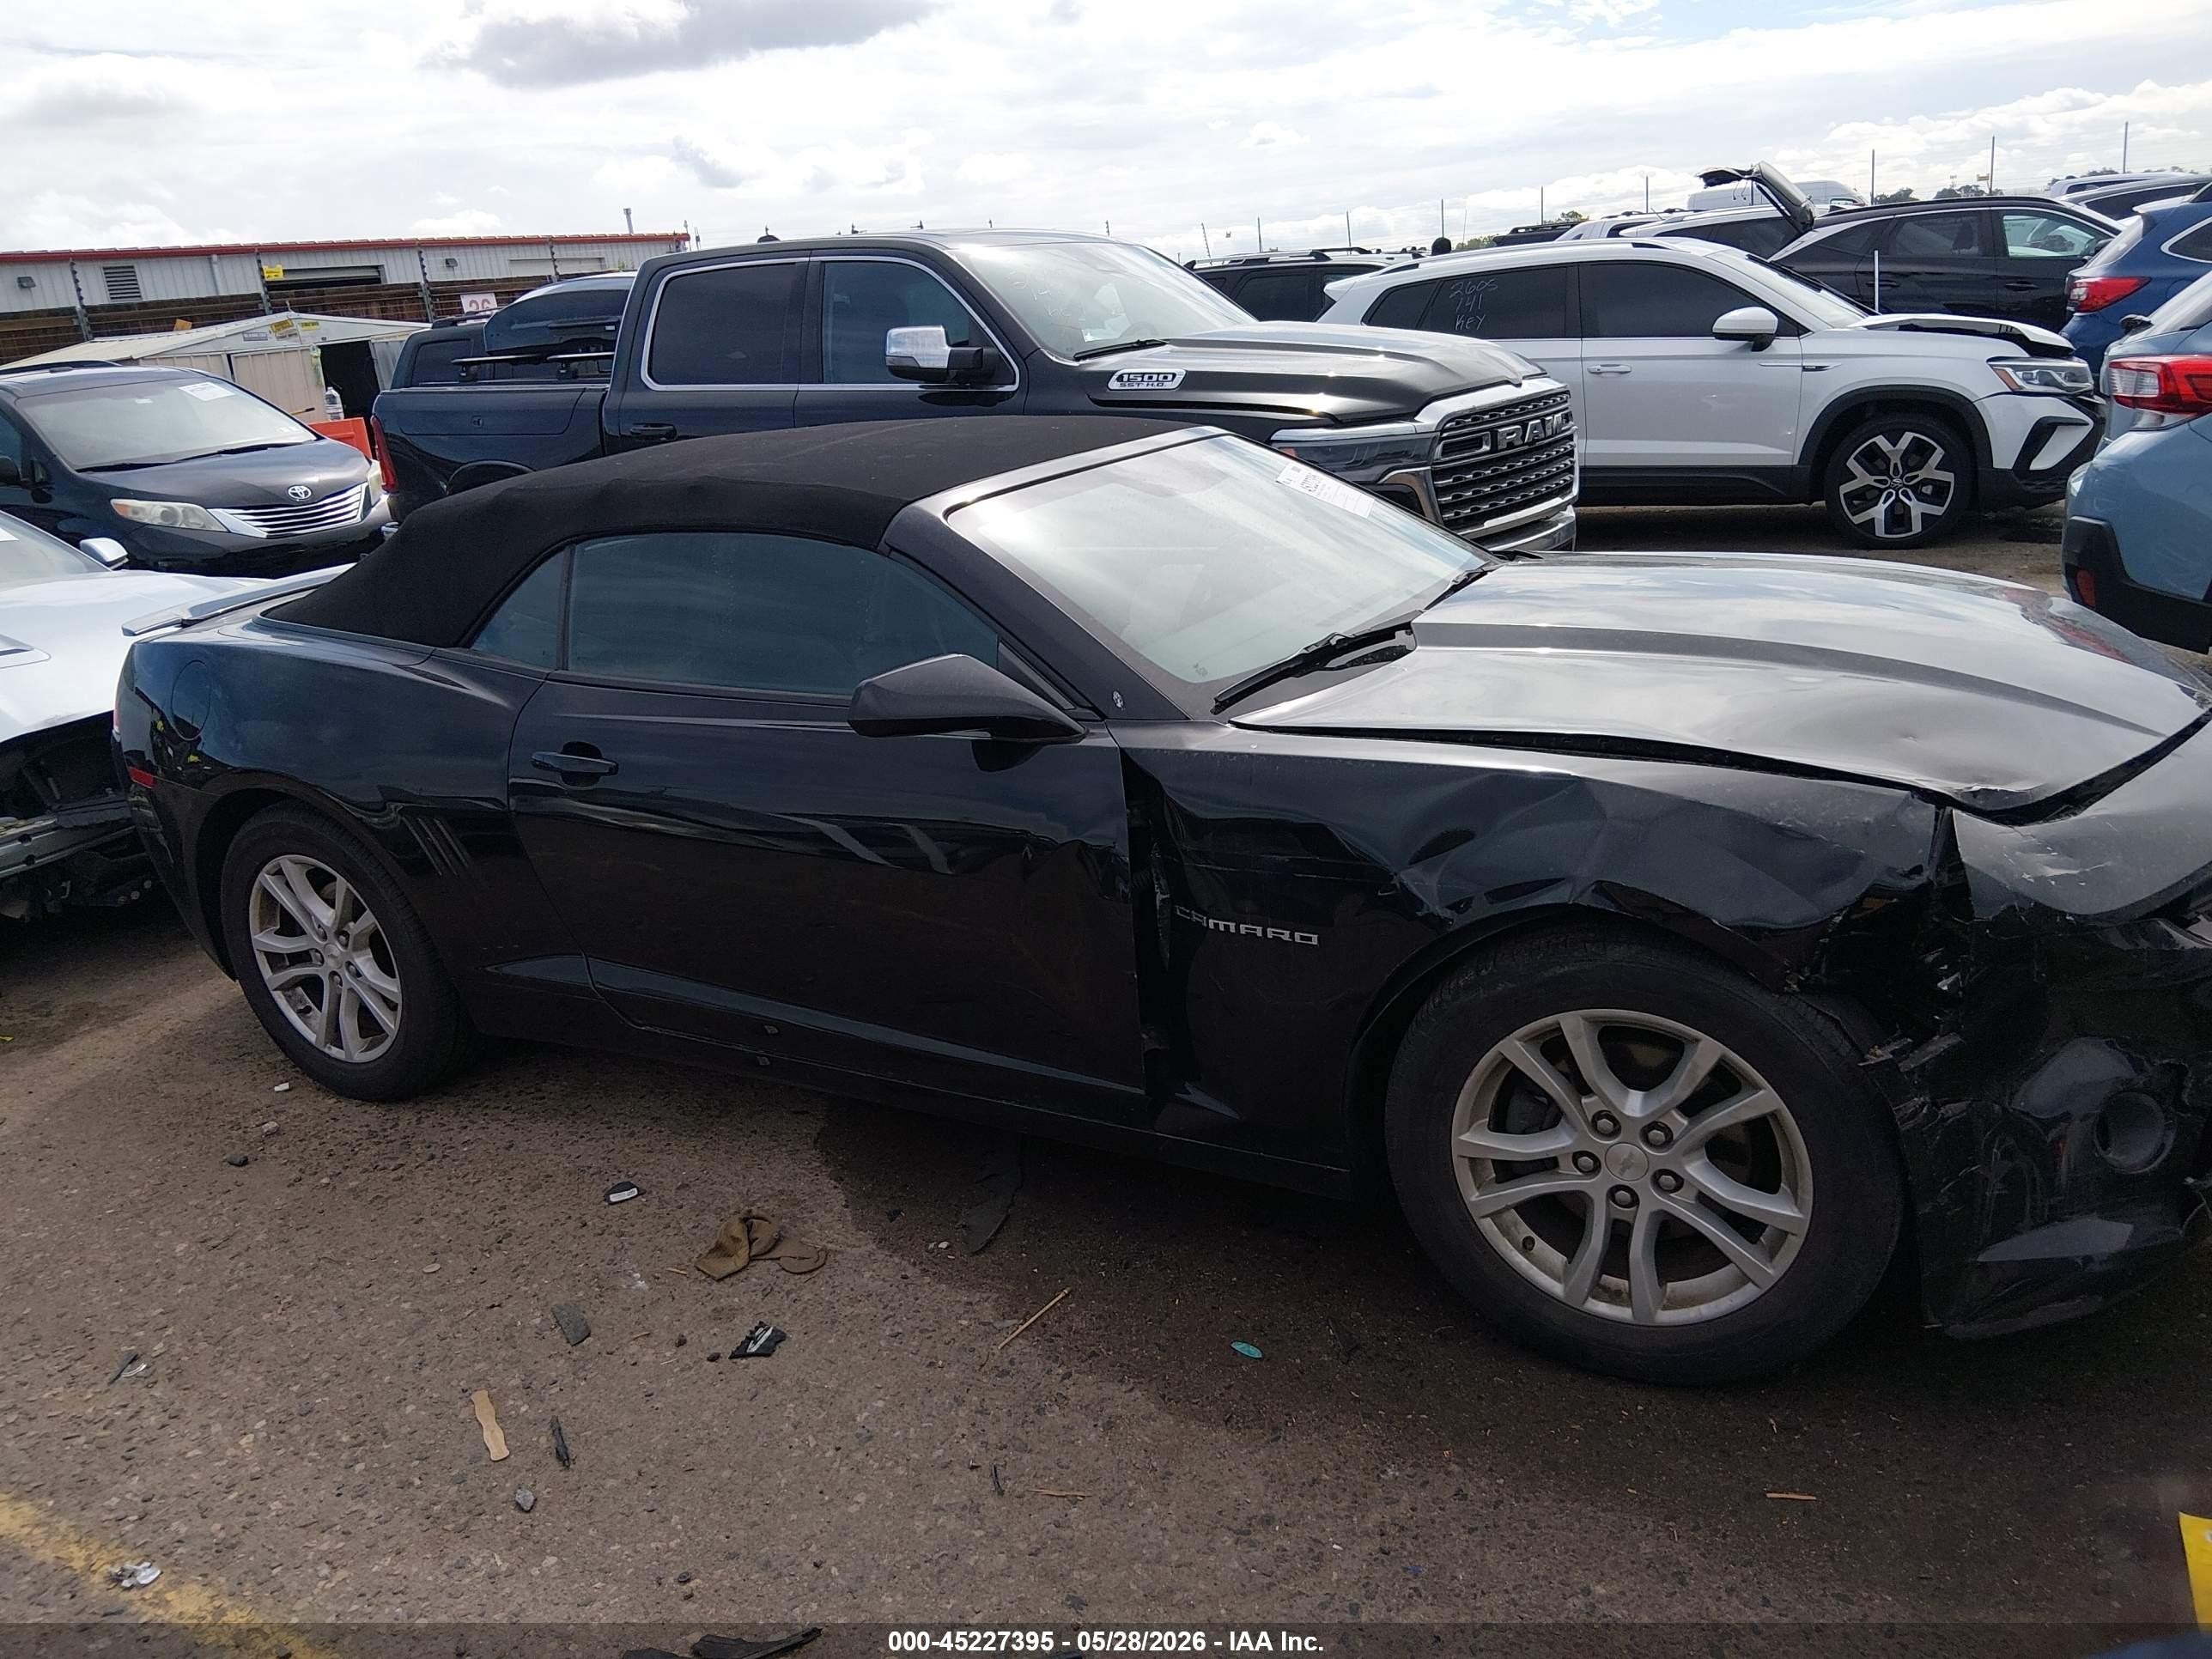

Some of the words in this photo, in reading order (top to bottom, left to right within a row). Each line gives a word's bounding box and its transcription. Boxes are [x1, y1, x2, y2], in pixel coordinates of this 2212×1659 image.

[1455, 313, 1486, 331] KEY
[1122, 374, 1174, 382] 1500
[1497, 413, 1563, 451] RAM
[1175, 905, 1320, 945] CAMARO
